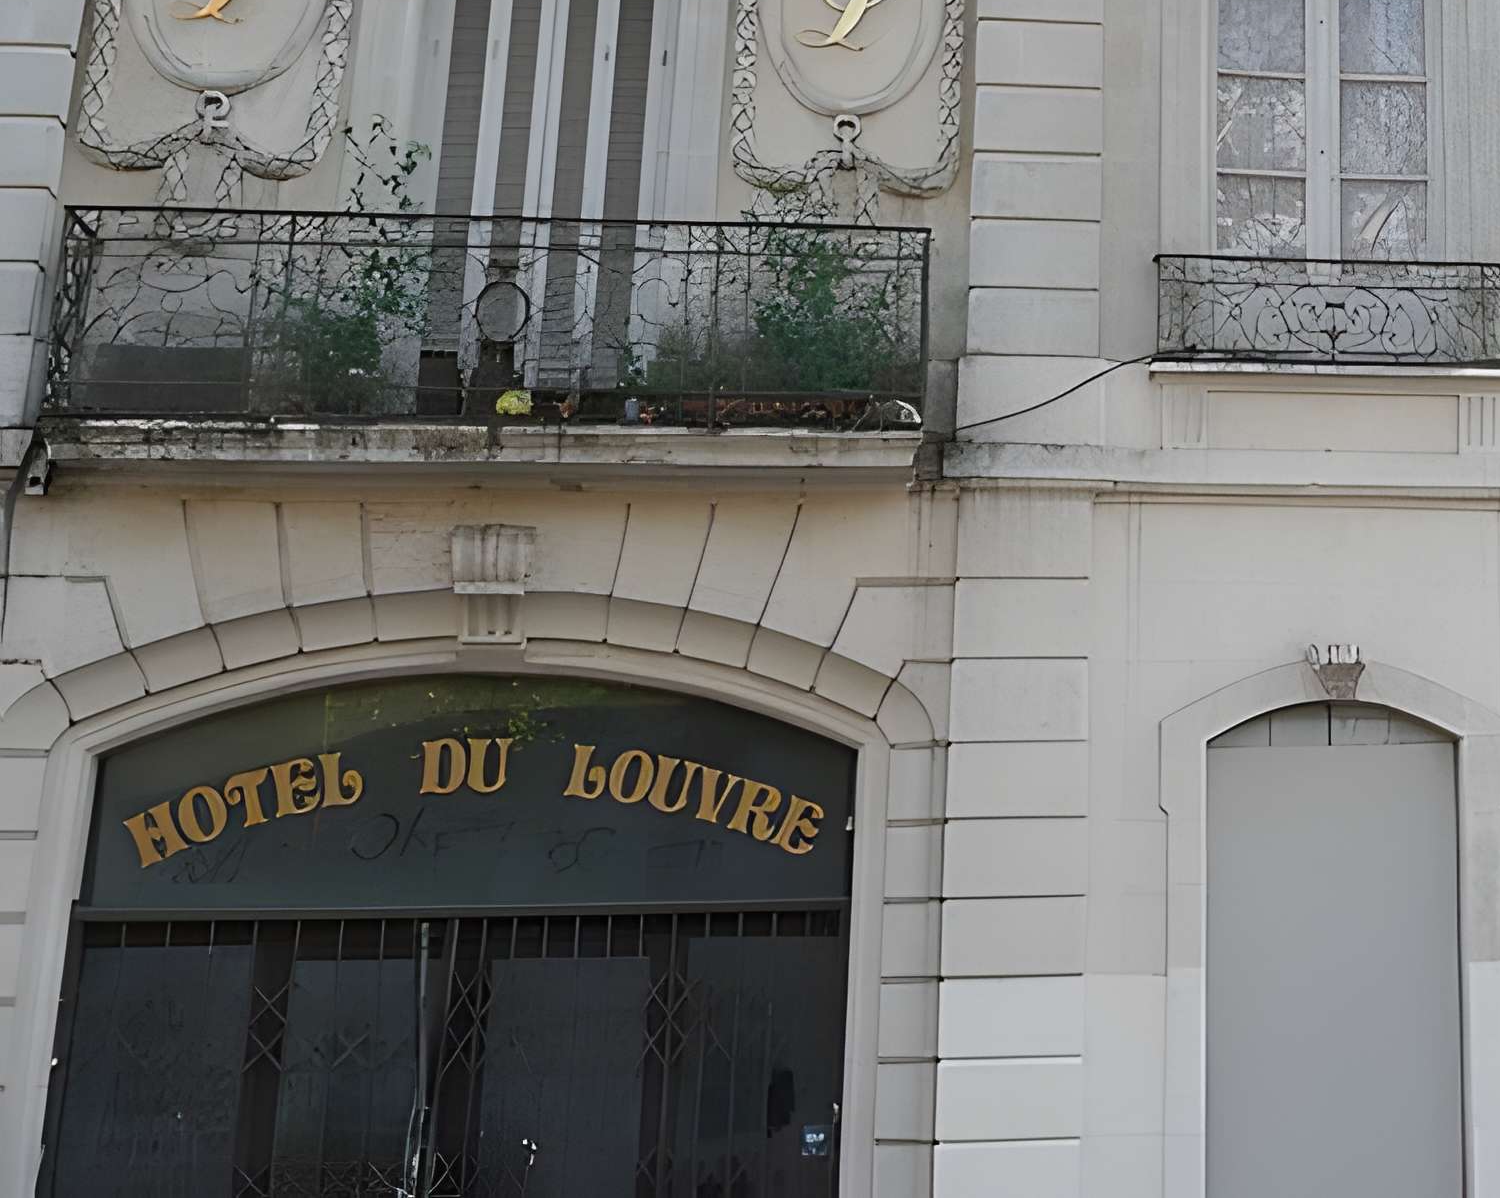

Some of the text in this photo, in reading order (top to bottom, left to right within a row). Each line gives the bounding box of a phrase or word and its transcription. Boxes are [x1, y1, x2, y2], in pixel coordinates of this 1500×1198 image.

[122, 752, 364, 869] HOTEL
[419, 737, 514, 795] DU
[563, 744, 827, 855] LOUVRE
